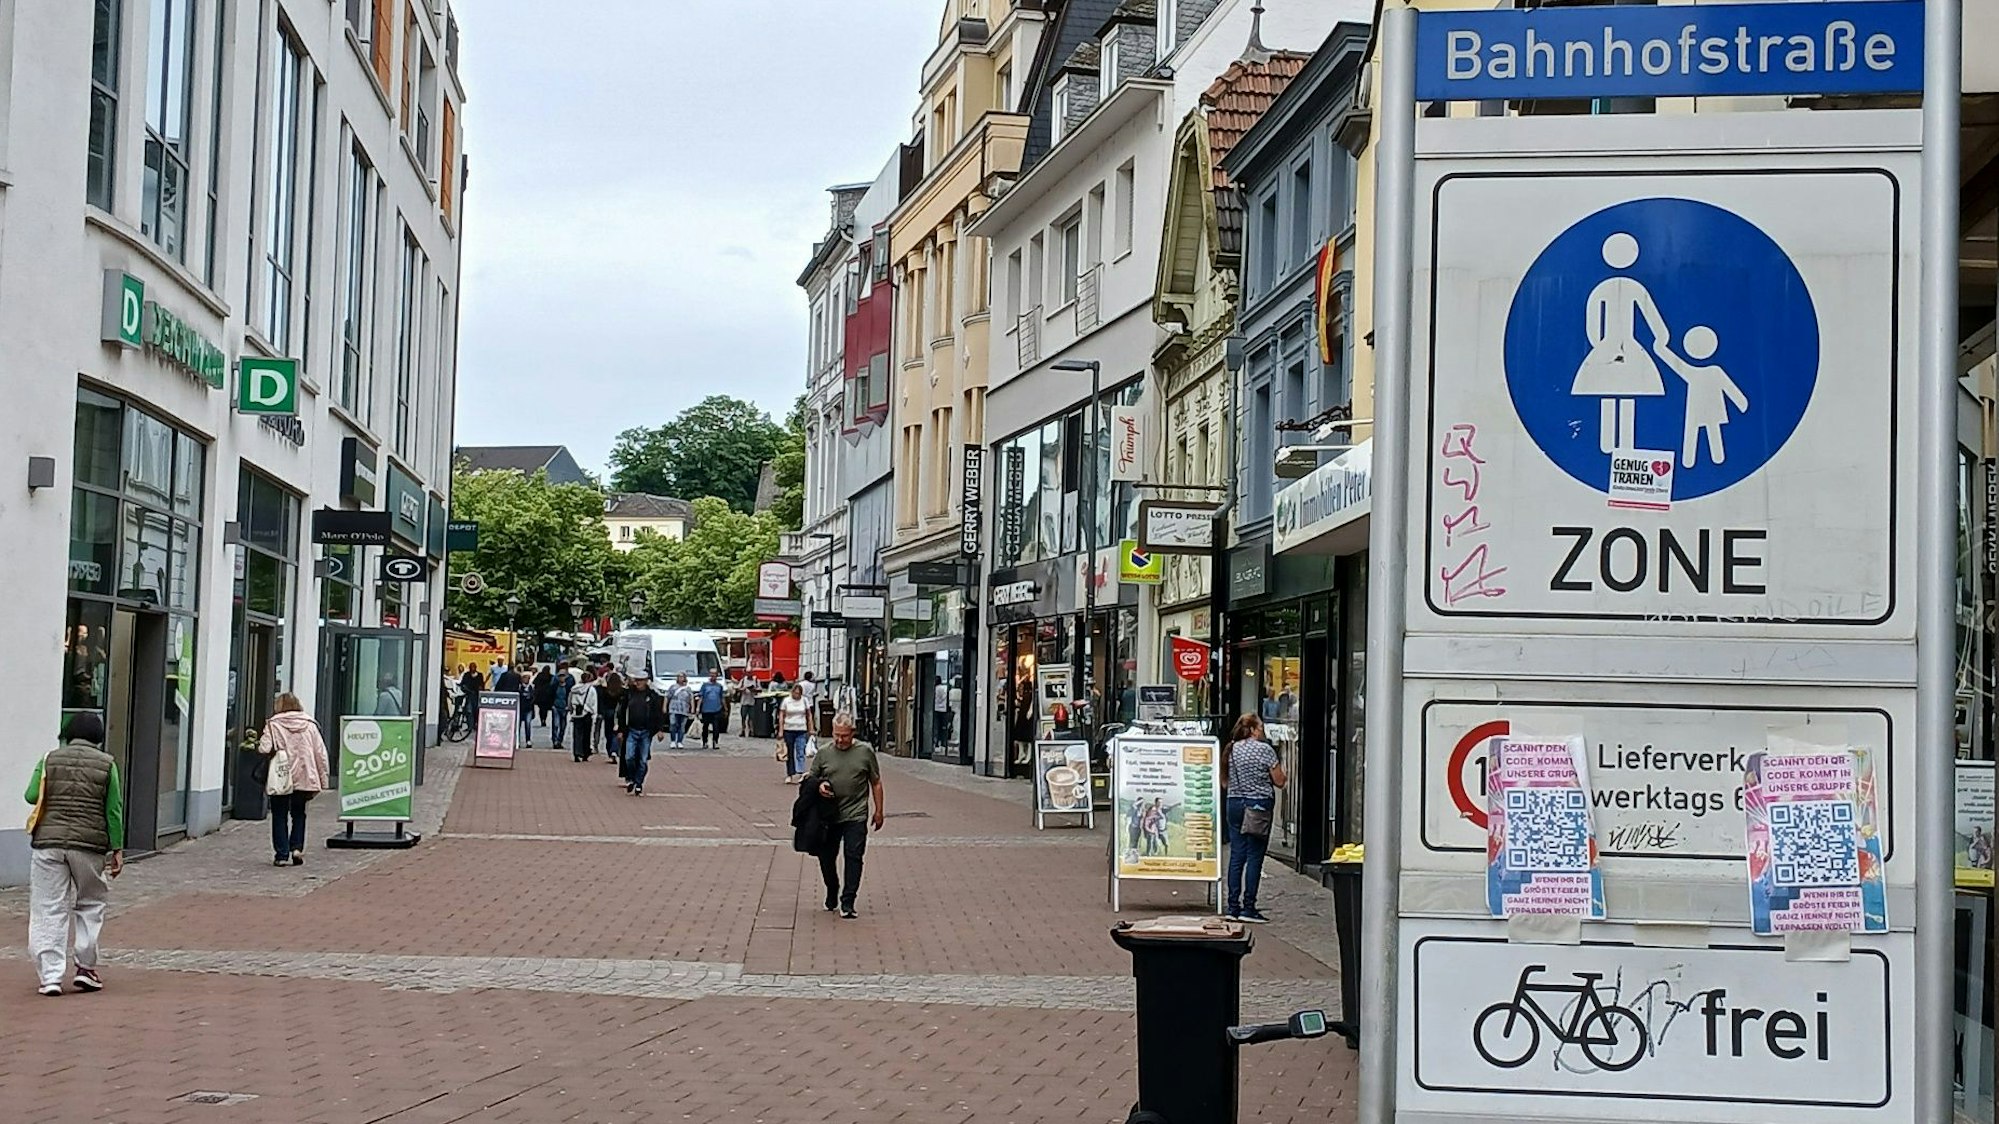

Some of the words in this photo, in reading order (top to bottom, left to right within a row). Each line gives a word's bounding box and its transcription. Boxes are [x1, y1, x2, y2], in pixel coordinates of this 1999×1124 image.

[1446, 20, 1896, 80] Bahnhofstraße
[122, 288, 140, 336] D
[250, 368, 288, 406] D
[1118, 416, 1140, 473] Triumph
[1613, 458, 1648, 472] GENUG
[966, 449, 980, 501] WEBER
[1150, 510, 1182, 519] LOTTO
[963, 504, 978, 553] GERRY
[321, 531, 349, 541] Marc
[1550, 527, 1766, 594] ZONE
[1503, 744, 1546, 753] SCANNT
[1546, 744, 1566, 753] DEN
[346, 747, 407, 778] -20%
[1506, 757, 1533, 766] CODE
[1763, 757, 1805, 767] SCANNT
[1807, 756, 1828, 766] DEN
[1507, 769, 1545, 778] UNSERE
[1767, 771, 1796, 780] CODE
[1799, 770, 1838, 779] KOMMT
[1840, 769, 1851, 777] IN
[1769, 783, 1809, 793] UNSERE
[1811, 782, 1852, 791] GRUPPE
[1591, 783, 1724, 817] werktags
[1535, 876, 1559, 884] WENN
[1576, 876, 1588, 884] DIE
[1803, 890, 1828, 899] WENN
[1846, 890, 1859, 898] DIE
[1564, 897, 1589, 905] NICHT
[1835, 911, 1861, 920] NICHT
[1700, 989, 1829, 1061] frei
